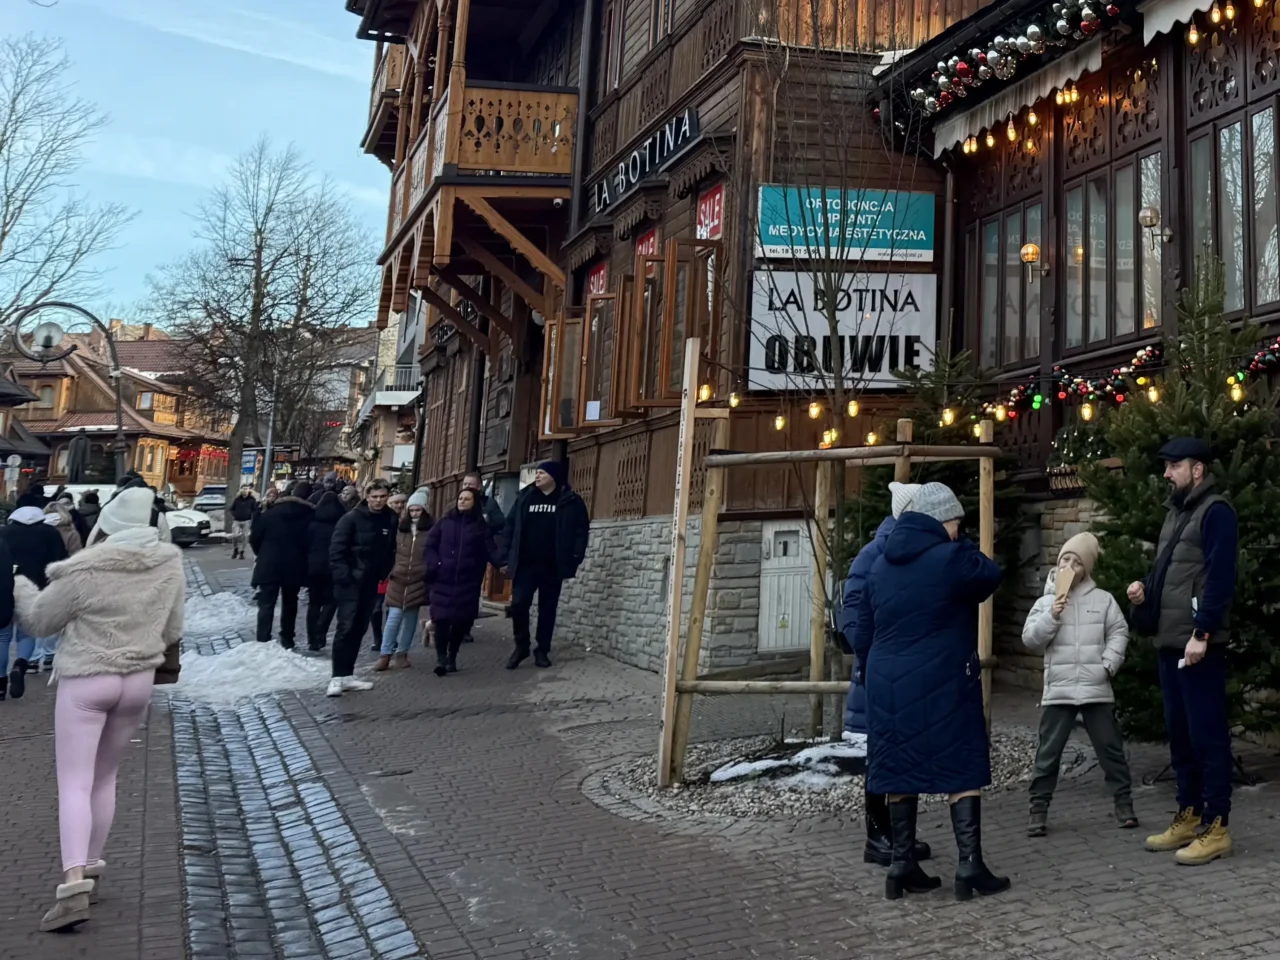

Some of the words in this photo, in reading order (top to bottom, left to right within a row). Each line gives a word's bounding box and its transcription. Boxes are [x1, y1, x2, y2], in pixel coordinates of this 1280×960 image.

[594, 178, 610, 213] LA
[618, 109, 690, 193] BOTINA
[700, 193, 721, 231] SALE
[818, 213, 882, 226] IMPANTY
[845, 227, 927, 241] ESTETYCZNA
[767, 287, 803, 312] LA
[813, 287, 921, 313] BOTINA
[765, 335, 921, 374] OBUWIE
